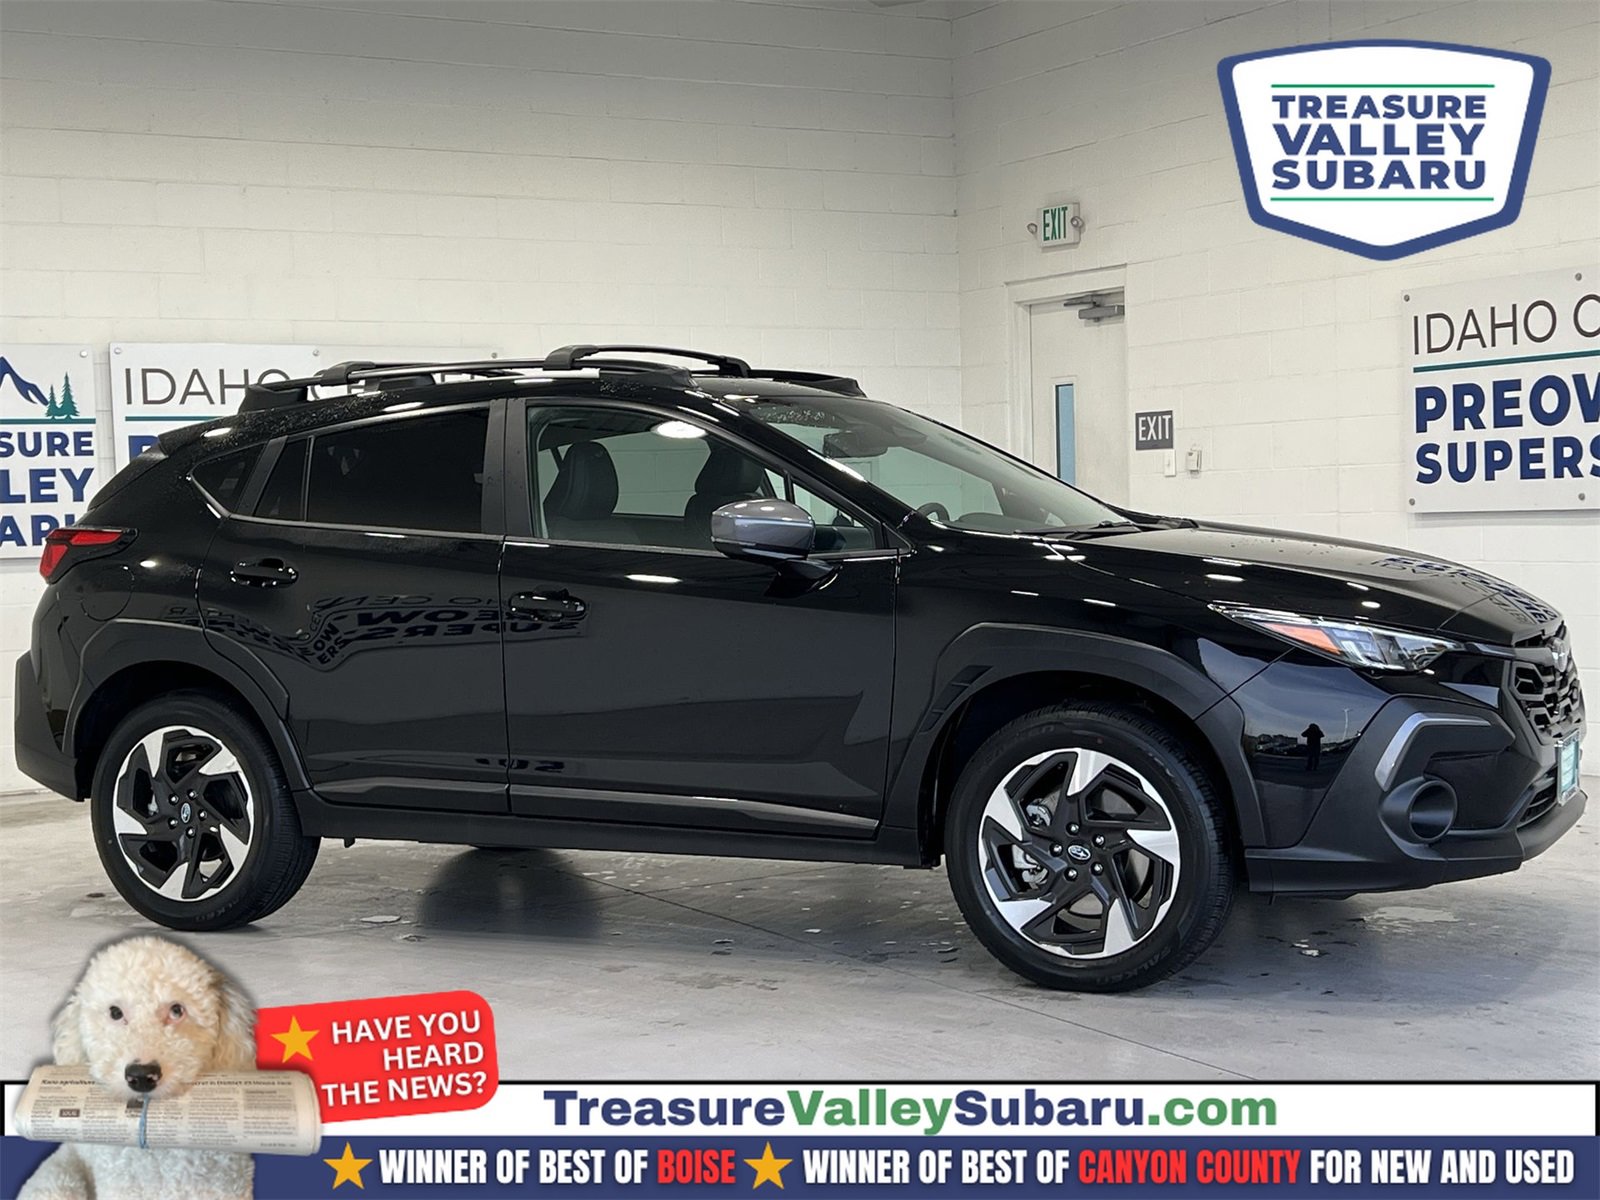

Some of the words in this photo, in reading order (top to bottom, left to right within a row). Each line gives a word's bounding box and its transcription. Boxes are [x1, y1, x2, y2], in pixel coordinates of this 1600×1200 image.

[1042, 206, 1068, 241] EXIT
[1413, 300, 1557, 355] IDAHO
[1138, 415, 1171, 441] EXIT
[0, 513, 77, 547] AR
